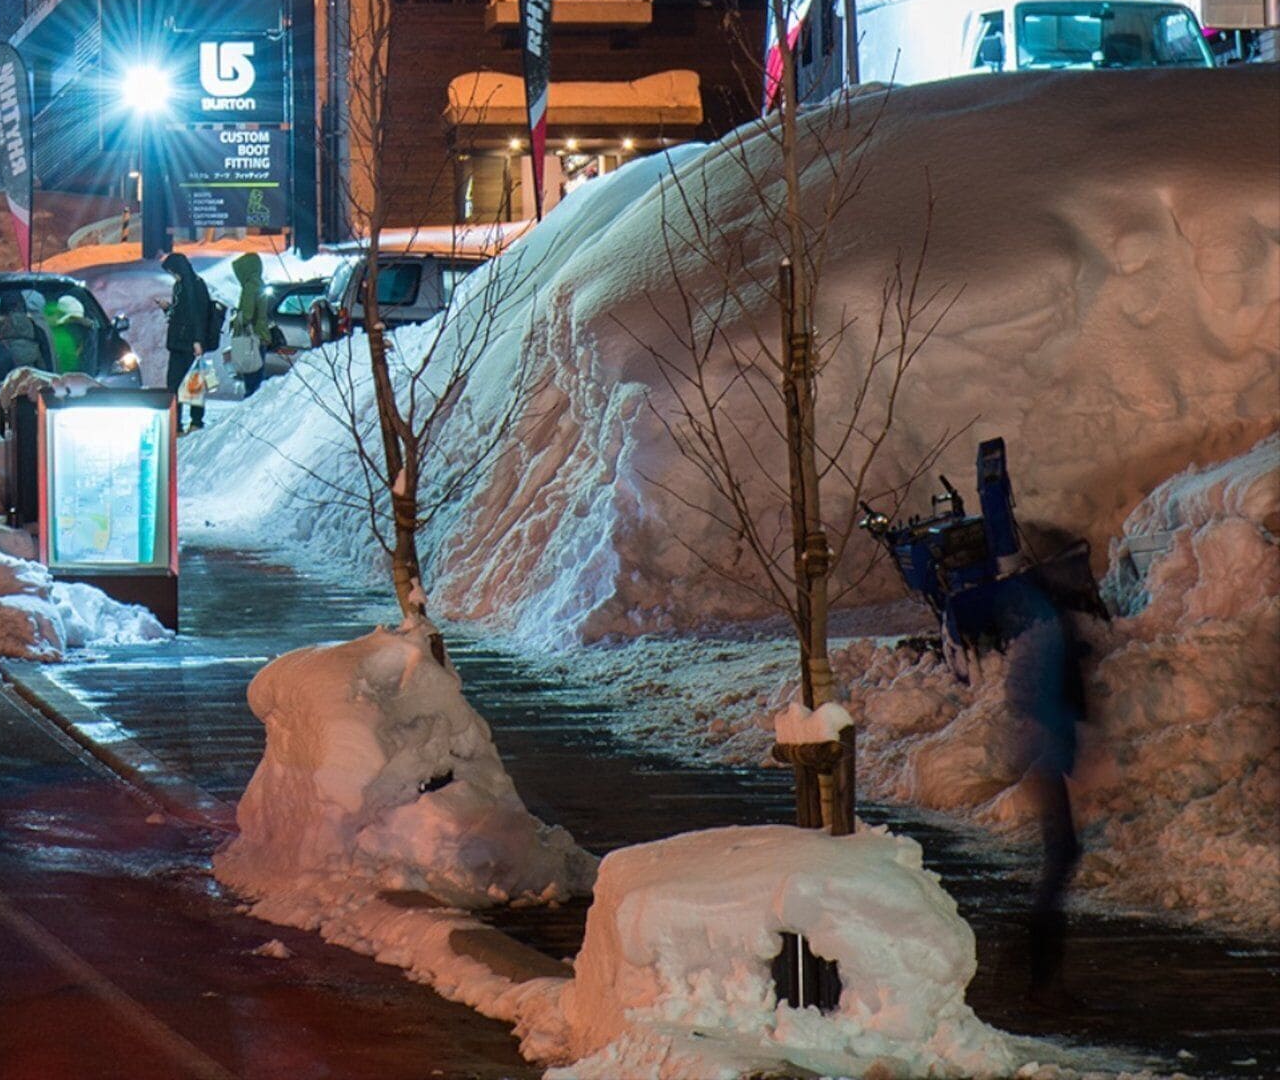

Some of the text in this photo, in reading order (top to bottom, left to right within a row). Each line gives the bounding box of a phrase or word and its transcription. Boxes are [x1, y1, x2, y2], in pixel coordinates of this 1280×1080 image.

[201, 97, 257, 111] BURTON
[220, 131, 270, 143] CUSTOM
[238, 144, 271, 156] BOOT
[224, 157, 271, 169] FITTING
